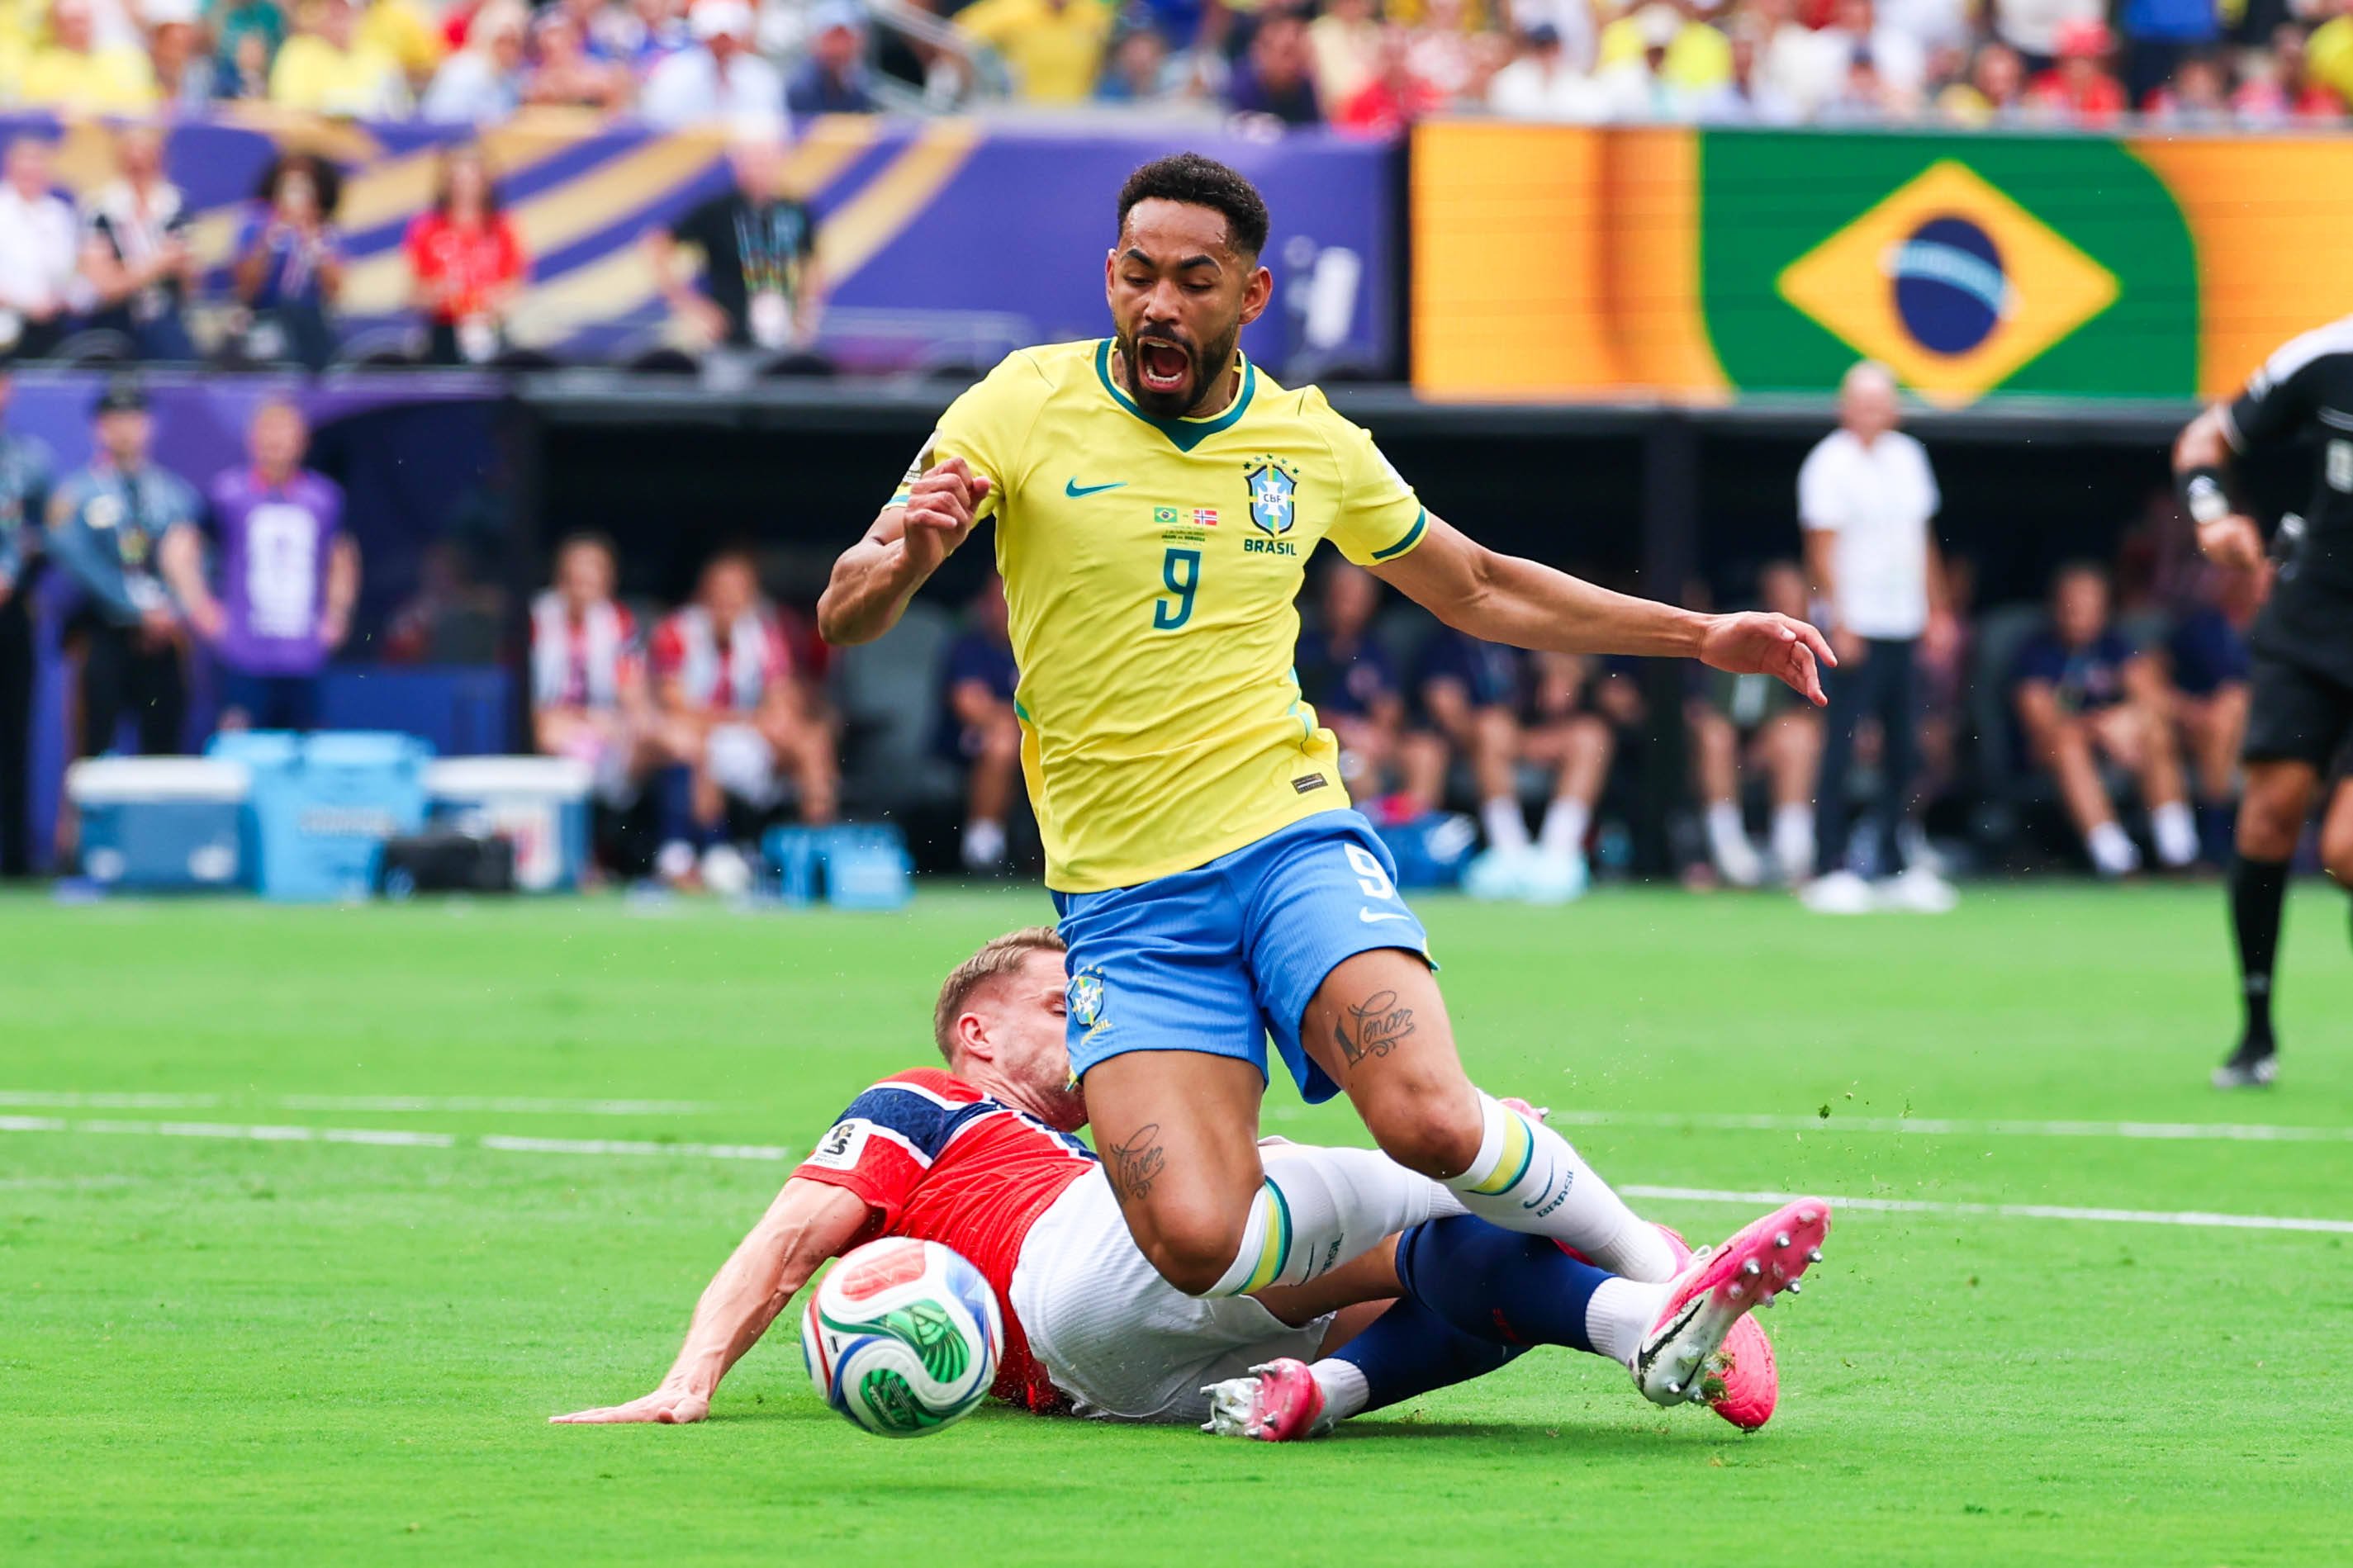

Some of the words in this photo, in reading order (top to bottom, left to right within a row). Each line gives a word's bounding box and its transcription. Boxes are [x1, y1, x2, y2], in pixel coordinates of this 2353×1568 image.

[1244, 538, 1297, 556] BRASIL
[1152, 548, 1201, 630] 9
[1344, 842, 1394, 899] 9
[1537, 1170, 1573, 1217] BRASIL
